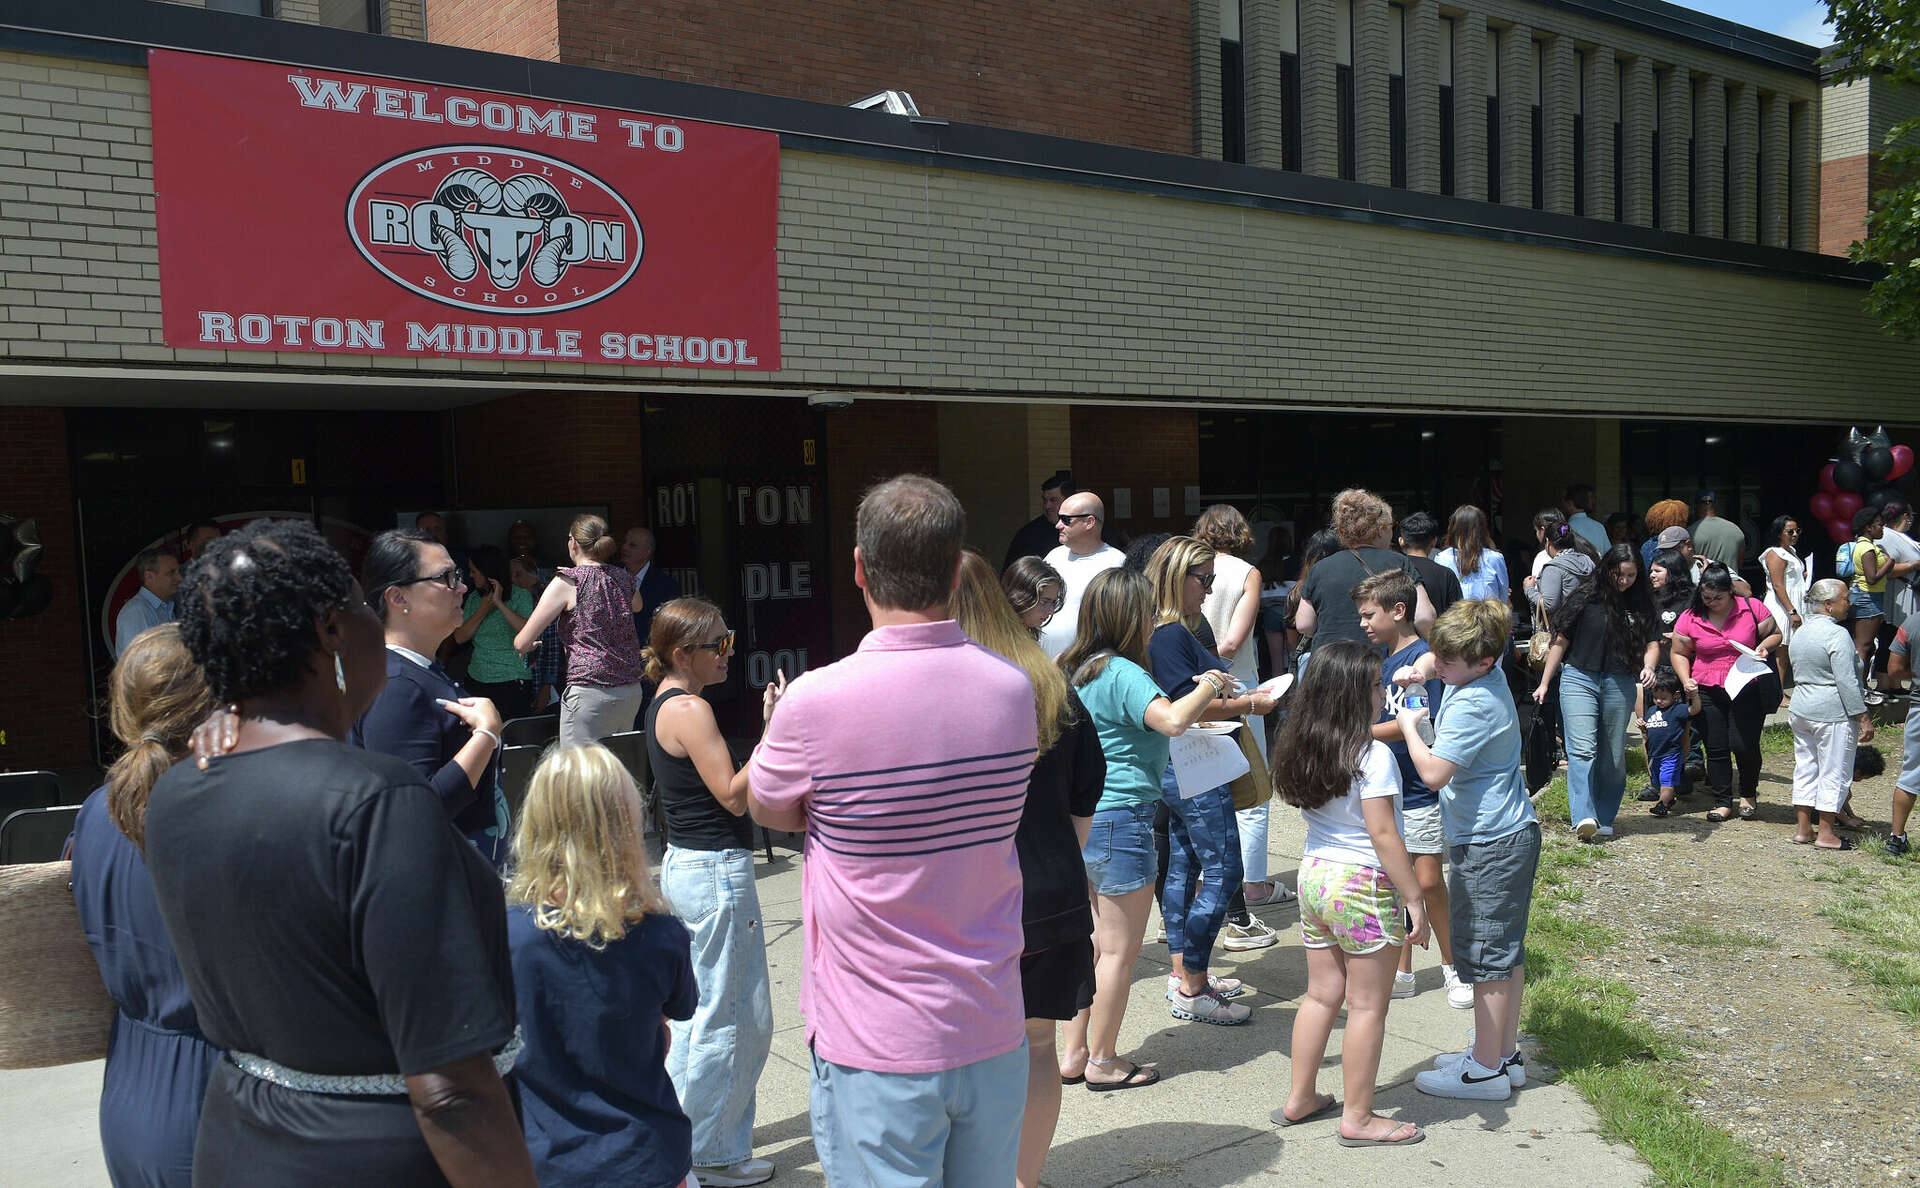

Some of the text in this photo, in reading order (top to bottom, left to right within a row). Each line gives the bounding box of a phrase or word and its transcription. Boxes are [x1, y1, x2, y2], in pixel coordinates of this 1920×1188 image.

[287, 74, 686, 153] WELCOME TO
[415, 155, 584, 190] MIDDLE
[368, 199, 626, 289] ROTON
[422, 275, 585, 305] SCHOOL
[198, 310, 758, 367] ROTON MIDDLE SCHOOL
